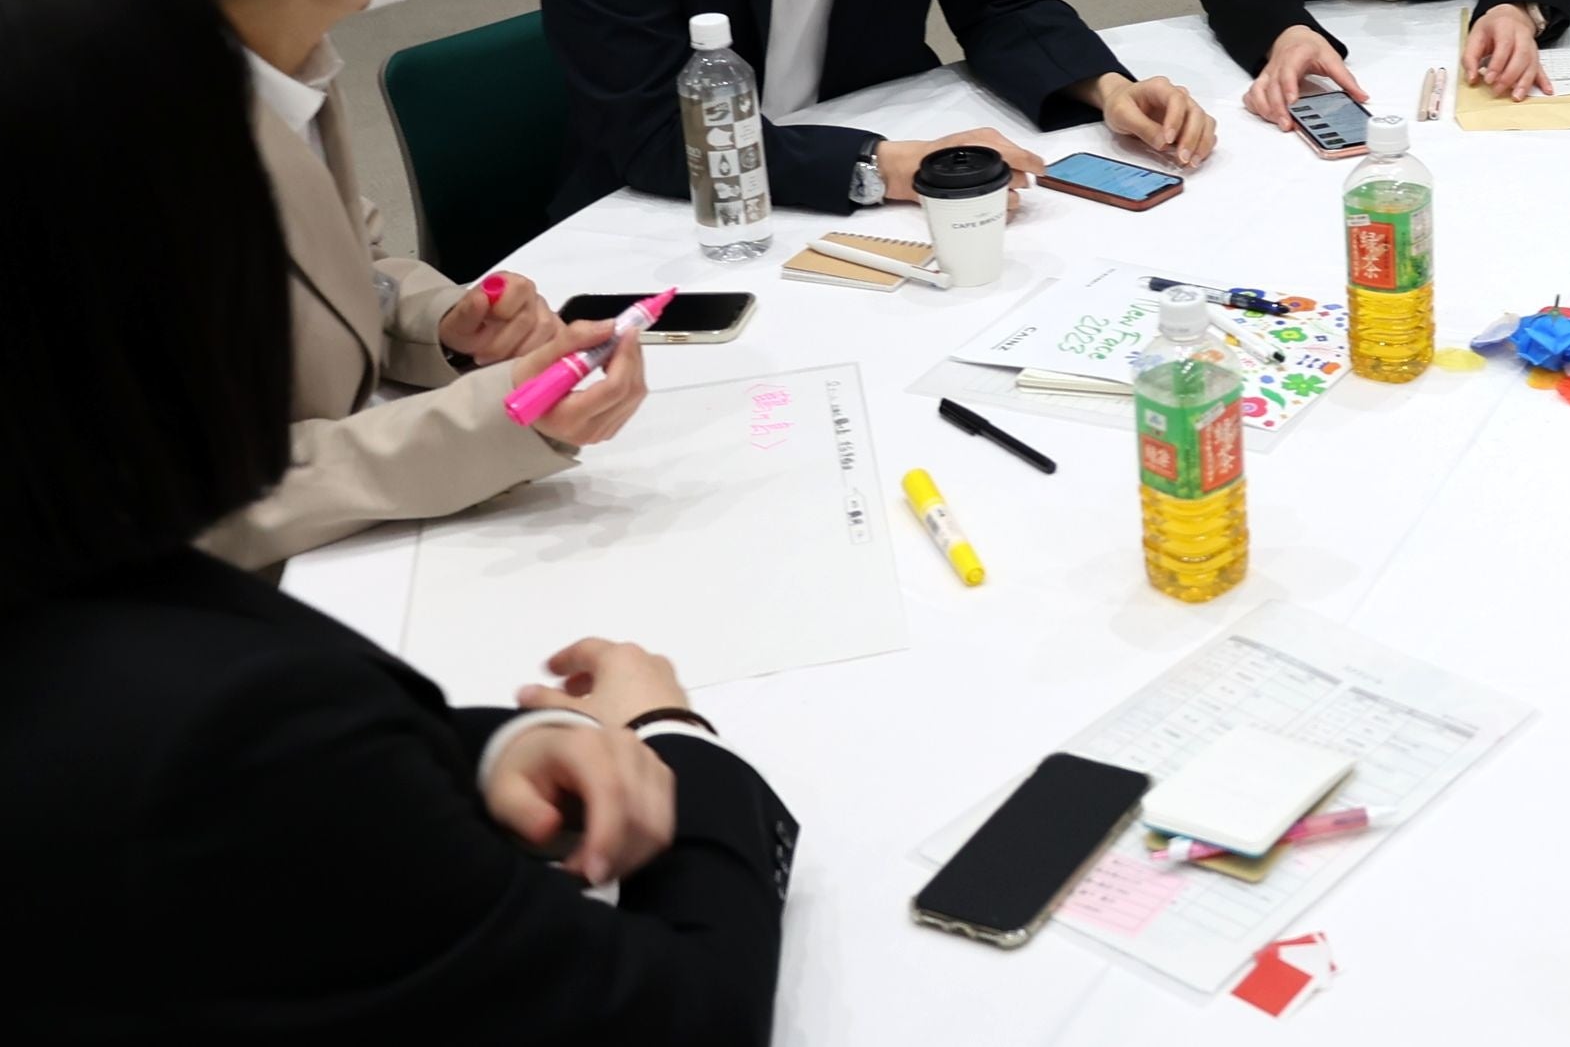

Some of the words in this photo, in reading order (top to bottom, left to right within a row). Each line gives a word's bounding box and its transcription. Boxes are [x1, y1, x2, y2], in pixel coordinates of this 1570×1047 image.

[1000, 326, 1037, 351] CAINZ
[1057, 315, 1109, 354] 2023
[1088, 329, 1142, 360] Face
